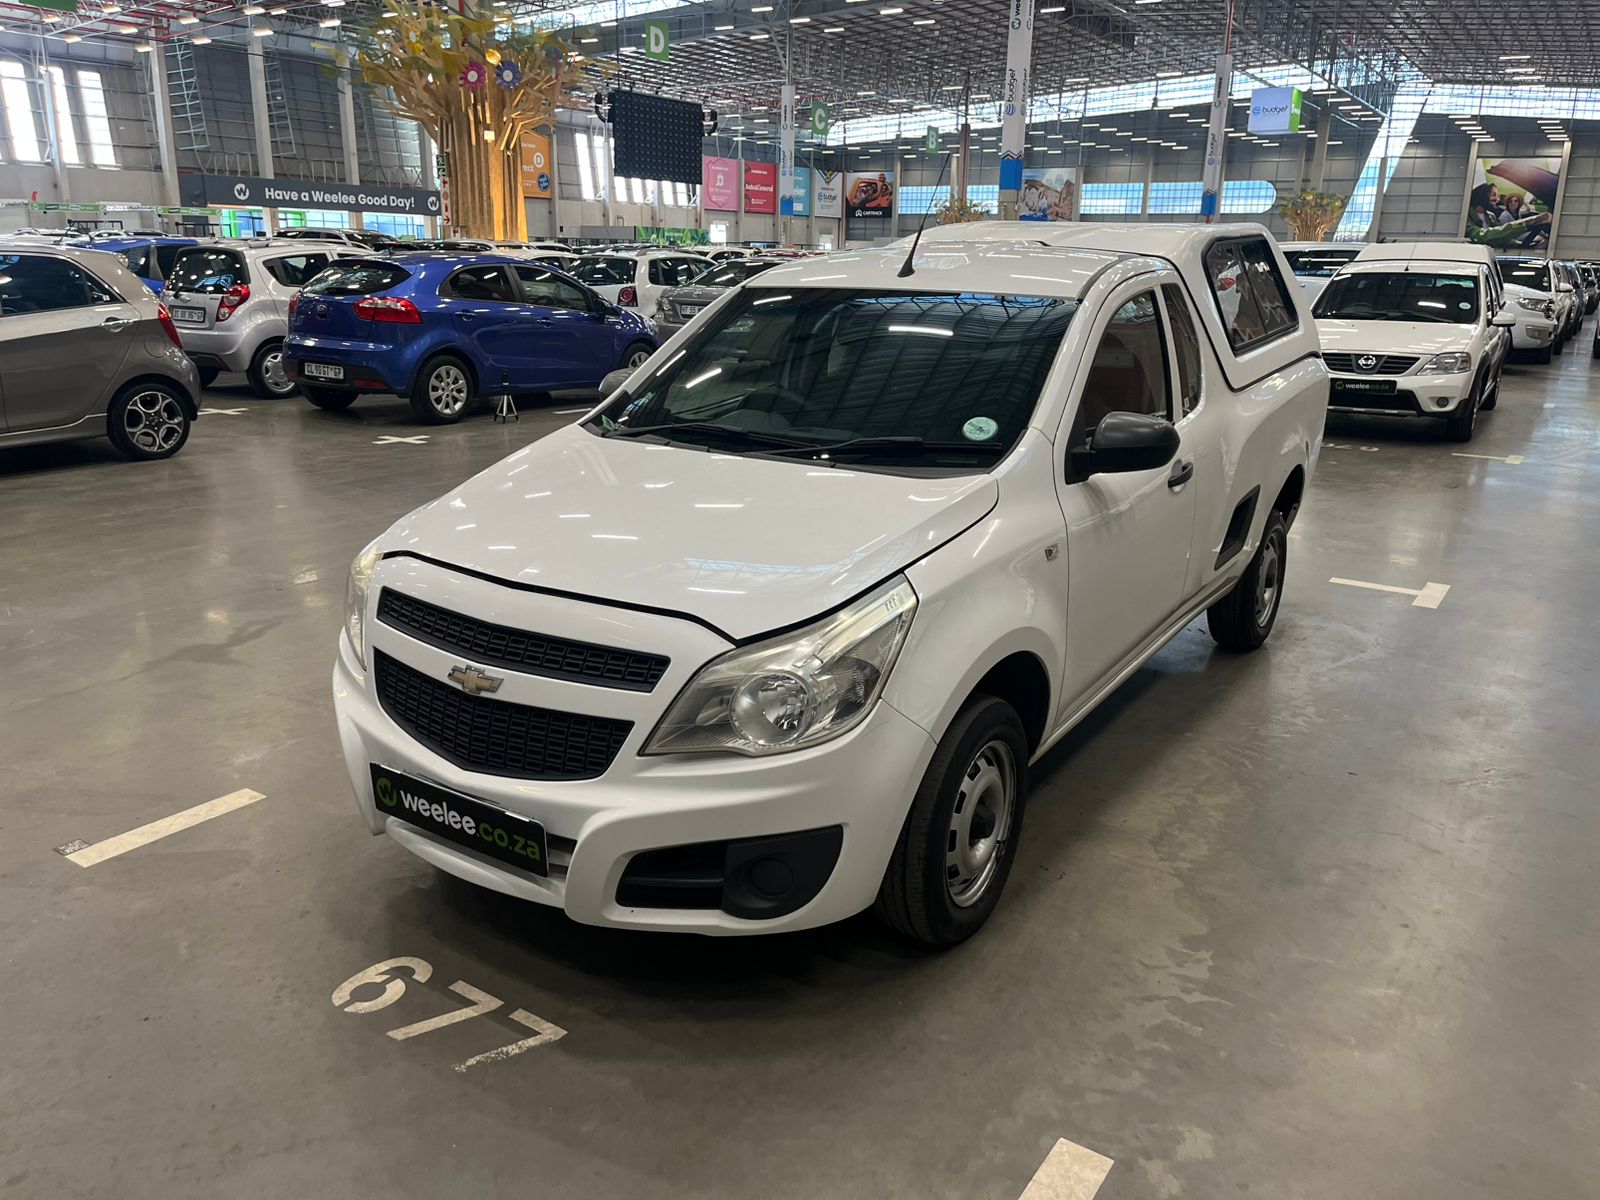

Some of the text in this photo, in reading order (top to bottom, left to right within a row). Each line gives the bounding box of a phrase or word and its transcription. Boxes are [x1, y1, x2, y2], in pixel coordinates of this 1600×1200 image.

[650, 26, 665, 53] D
[1008, 68, 1017, 103] budget
[815, 108, 826, 130] C
[1261, 105, 1288, 116] budget
[929, 130, 936, 149] B
[264, 187, 415, 211] Have a Weelee Good Day!
[399, 789, 541, 861] weelee.co.za
[331, 956, 569, 1073] 677
